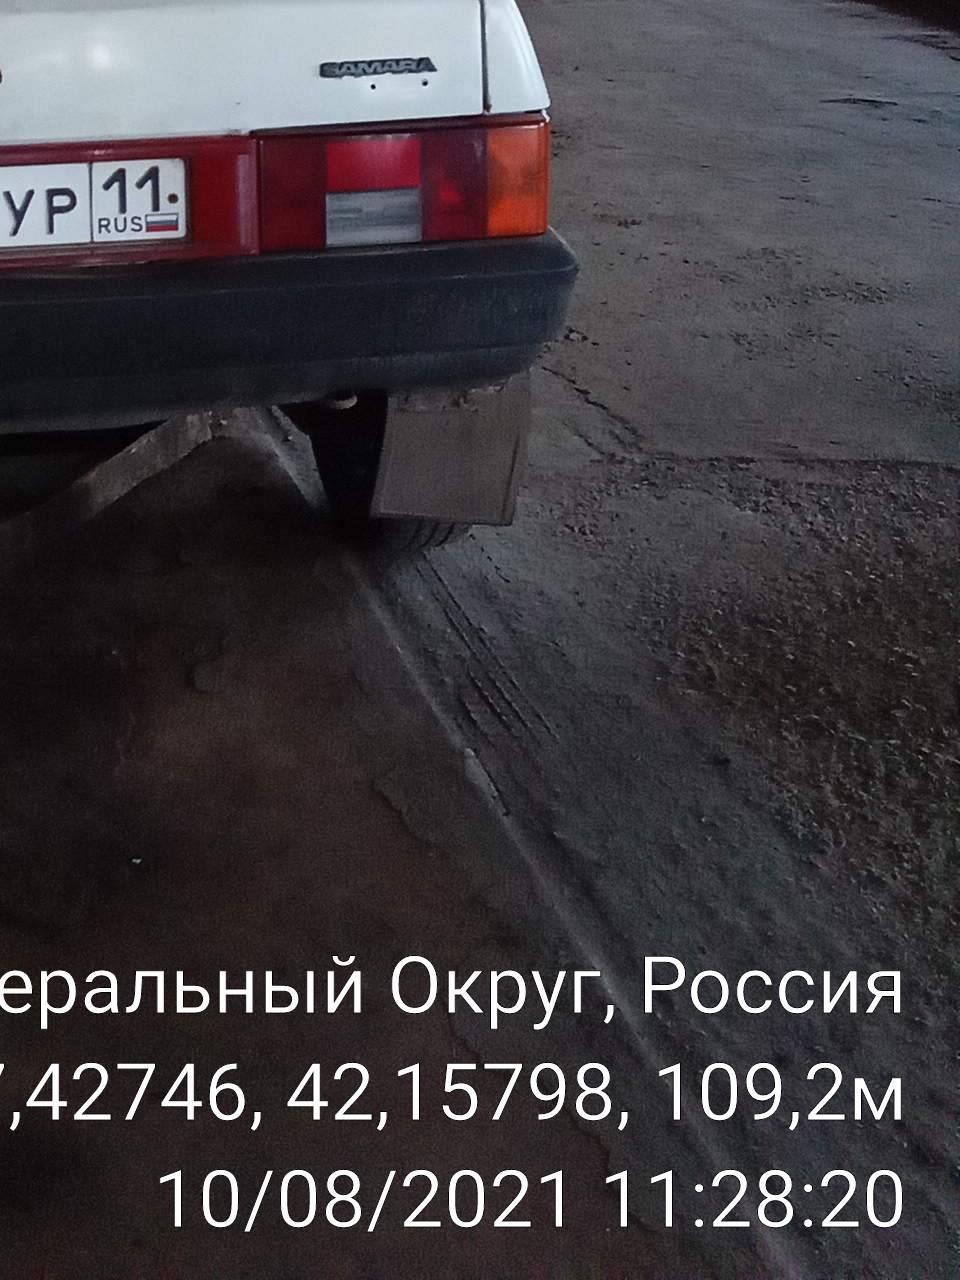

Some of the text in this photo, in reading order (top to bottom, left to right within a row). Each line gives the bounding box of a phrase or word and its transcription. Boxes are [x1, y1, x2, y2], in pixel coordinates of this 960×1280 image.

[319, 57, 438, 78] SAMARA
[102, 166, 160, 213] 11
[98, 216, 144, 235] RUS
